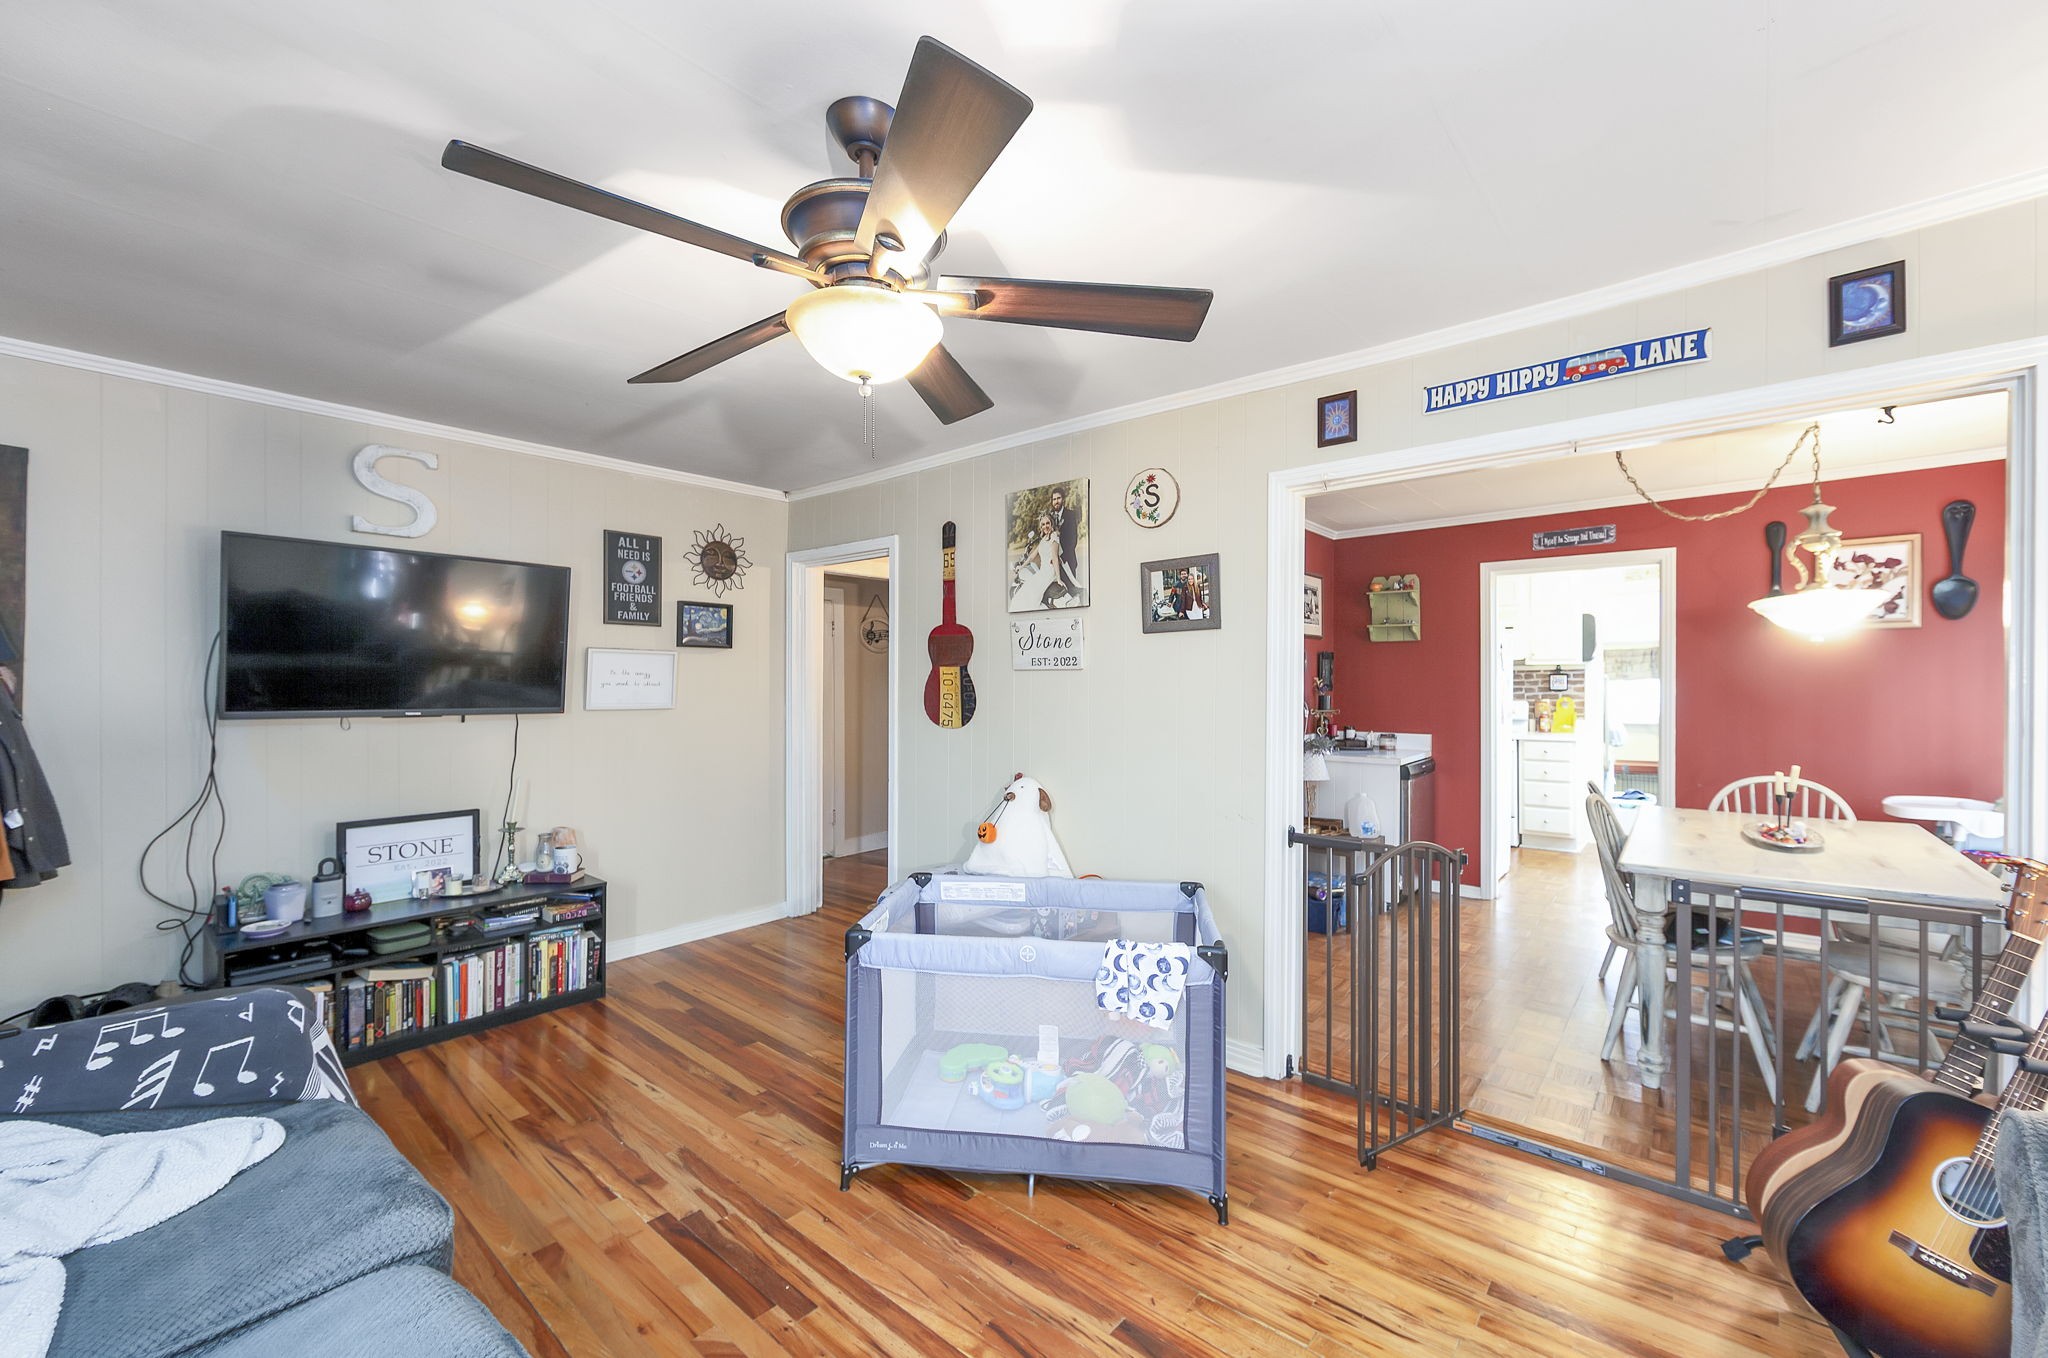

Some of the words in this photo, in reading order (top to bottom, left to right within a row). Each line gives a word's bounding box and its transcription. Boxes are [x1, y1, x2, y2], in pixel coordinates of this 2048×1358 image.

[1430, 377, 1490, 409] HAPPY
[1496, 362, 1560, 396] HIPPY
[1634, 333, 1698, 368] LANE
[352, 444, 438, 539] S
[1144, 483, 1160, 508] S
[618, 536, 639, 549] ALL
[646, 540, 650, 551] I
[617, 548, 640, 560] NEED
[642, 551, 650, 561] IS
[611, 582, 656, 595] FOOTBALL
[614, 592, 653, 603] FRIENDS
[629, 602, 637, 611] &
[617, 611, 650, 621] FAMILY
[1031, 657, 1051, 667] EST:
[1053, 656, 1078, 667] 2022
[367, 837, 454, 864] STONE
